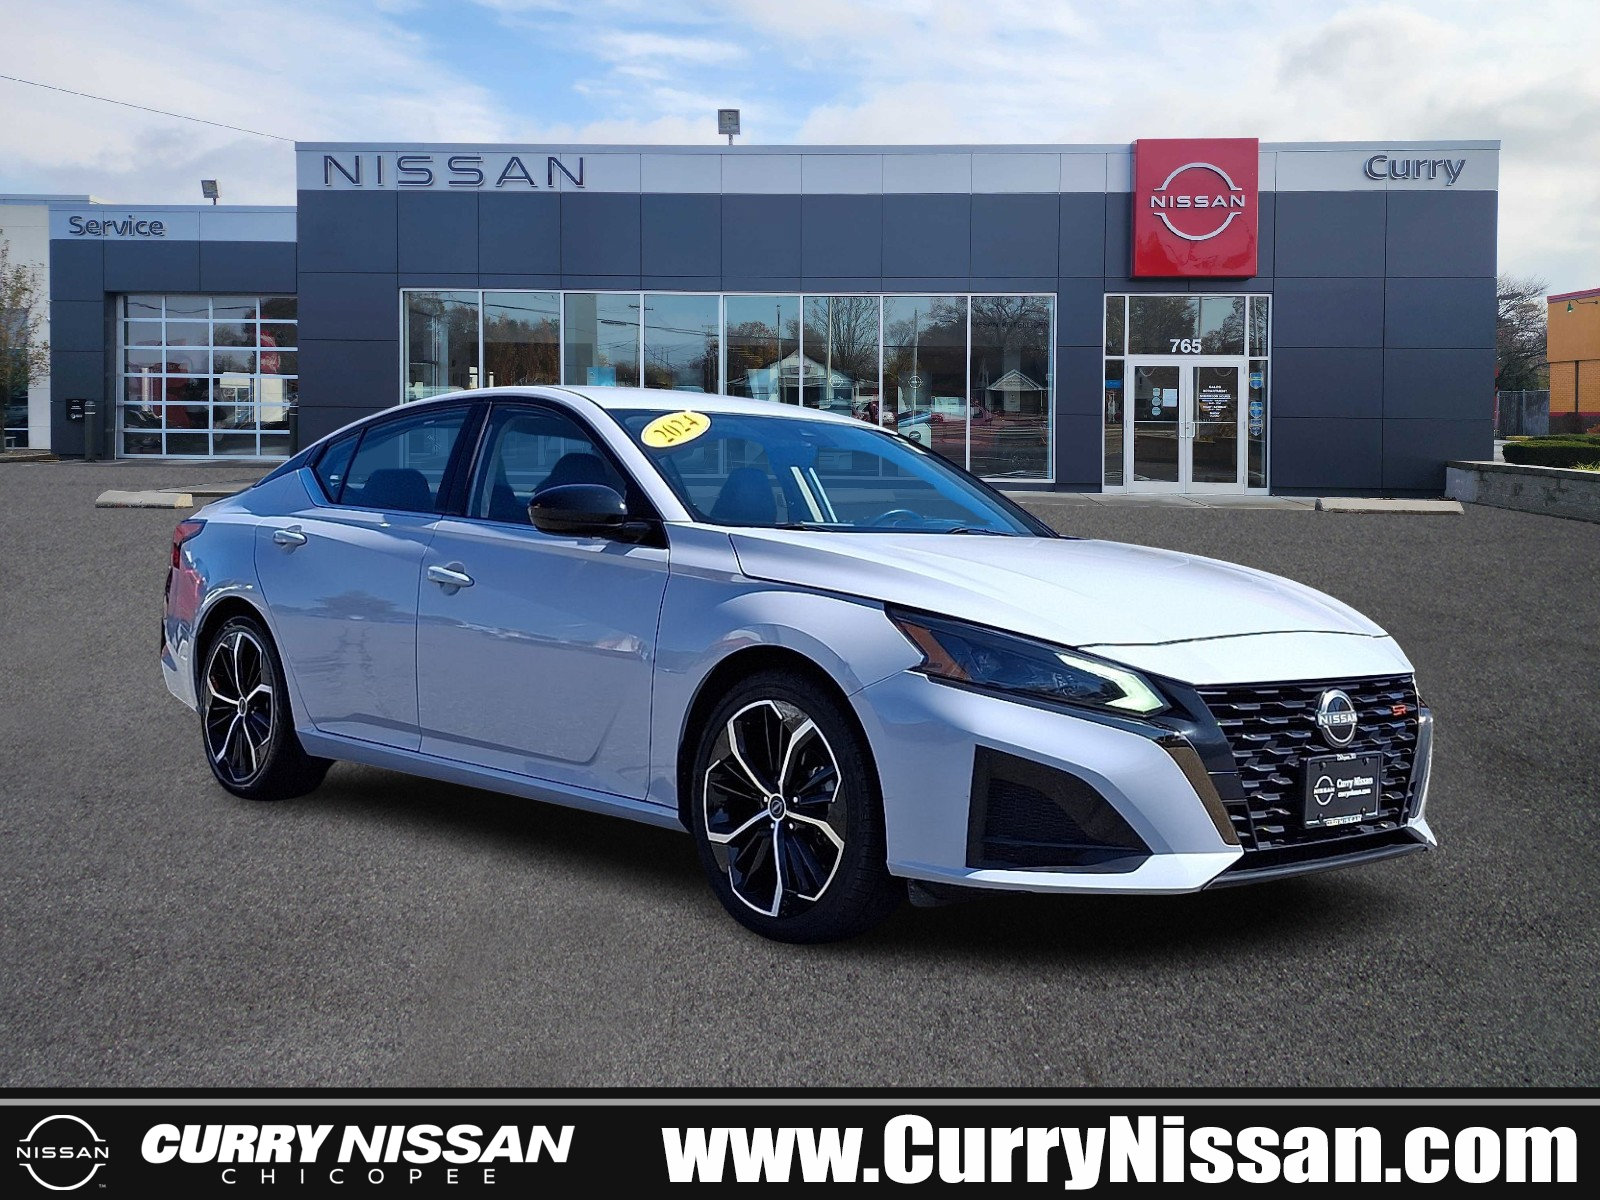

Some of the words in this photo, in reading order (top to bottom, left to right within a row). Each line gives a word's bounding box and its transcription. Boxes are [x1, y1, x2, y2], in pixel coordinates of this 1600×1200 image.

[323, 155, 586, 188] NISSAN
[1365, 154, 1466, 186] Curry
[1150, 194, 1246, 208] NISSAN
[68, 214, 166, 238] Service
[1169, 338, 1202, 354] 765
[653, 414, 700, 443] 2024
[1392, 704, 1407, 716] SR
[1318, 713, 1358, 725] NISSAN
[1336, 778, 1353, 789] Curry
[1353, 776, 1373, 787] Nissan
